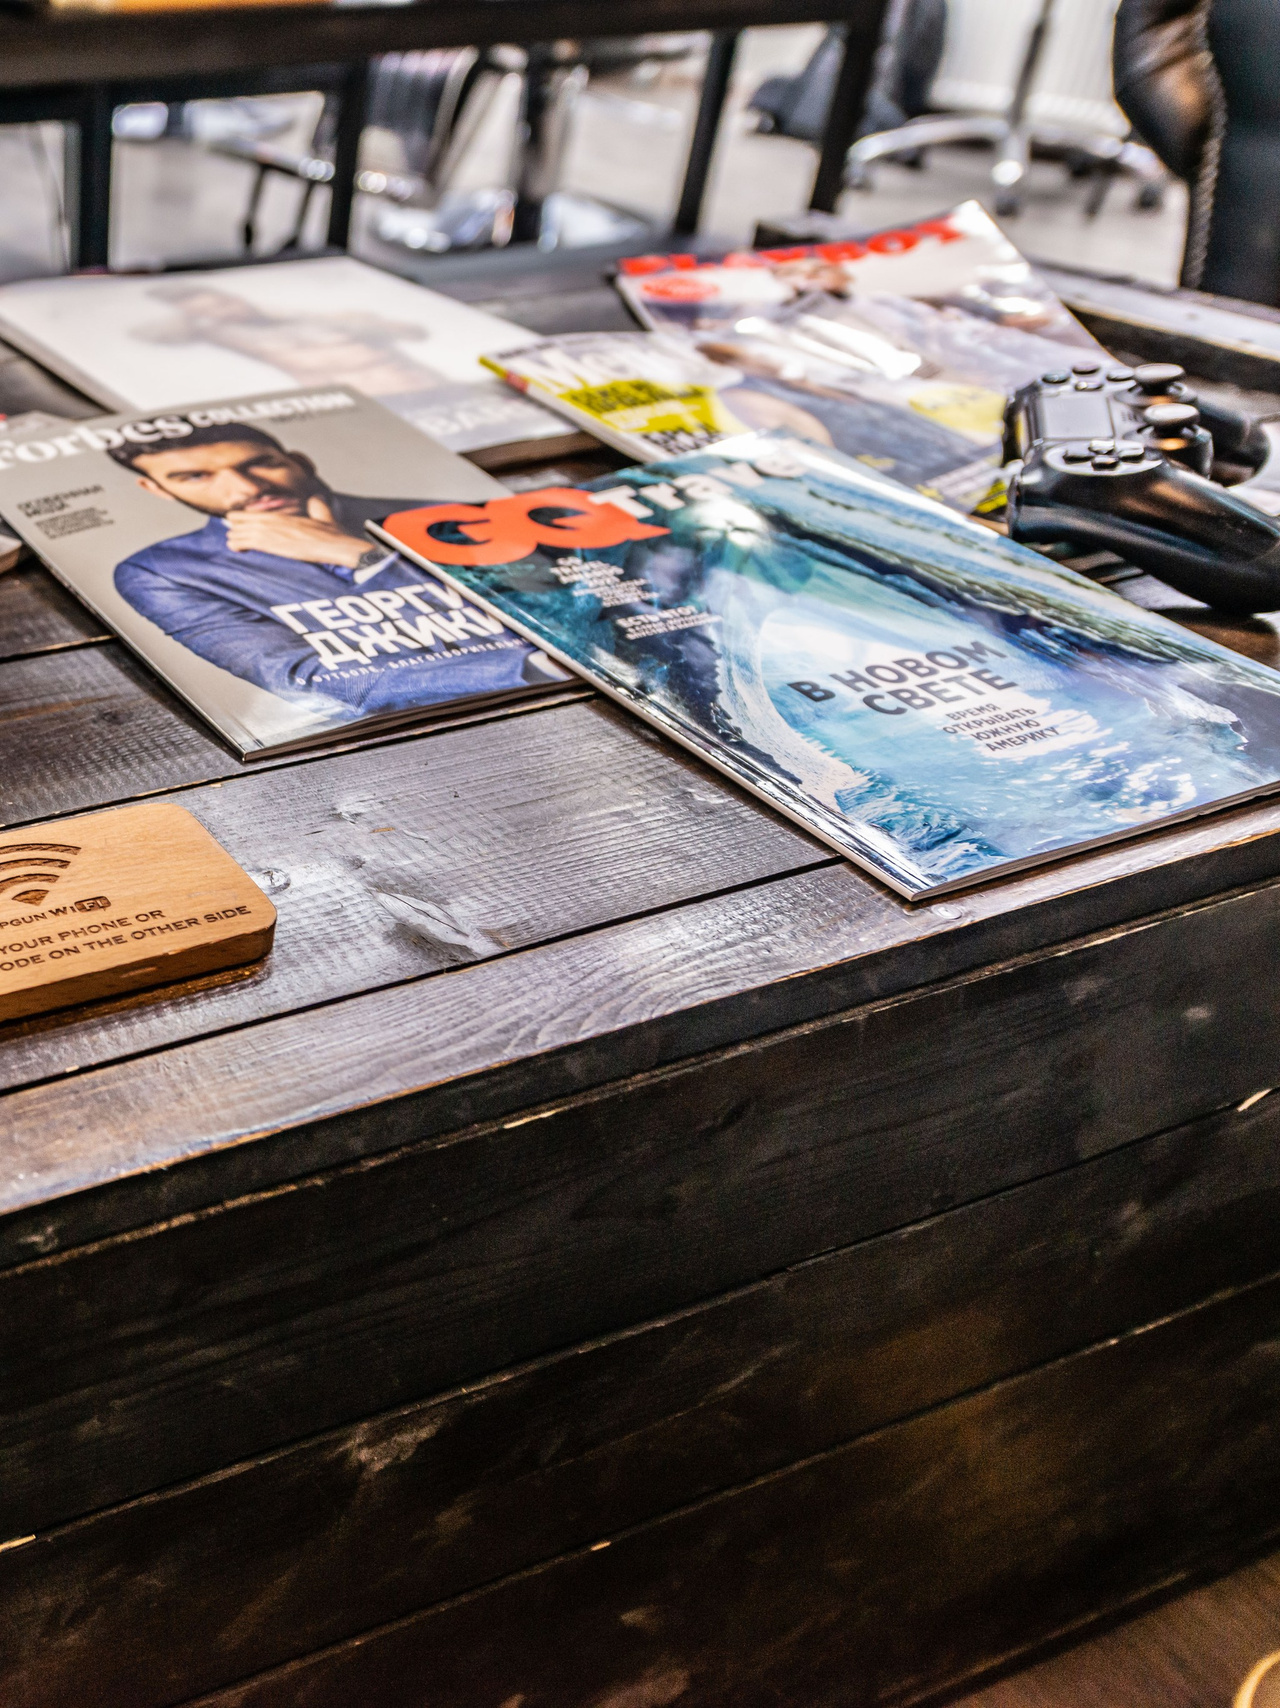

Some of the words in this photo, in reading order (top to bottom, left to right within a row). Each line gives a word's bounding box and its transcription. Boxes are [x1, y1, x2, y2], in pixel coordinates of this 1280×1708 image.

[187, 391, 356, 427] COLLECTION
[382, 486, 671, 566] GQ
[786, 680, 837, 703] В
[829, 640, 1008, 692] НОВОМ
[862, 668, 1019, 715] СВЕТЕ
[942, 706, 1037, 734] ОТКРЫВАТЬ
[945, 702, 1002, 721] ВРЕМЯ
[971, 718, 1041, 741] ЮЖНУЮ
[985, 725, 1061, 752] АМЕРИКУ
[48, 945, 82, 960] ON
[82, 934, 129, 950] THE
[130, 917, 201, 941] OTHER
[202, 905, 252, 923] SIDE
[57, 917, 133, 941] PHONE
[134, 909, 167, 923] OR
